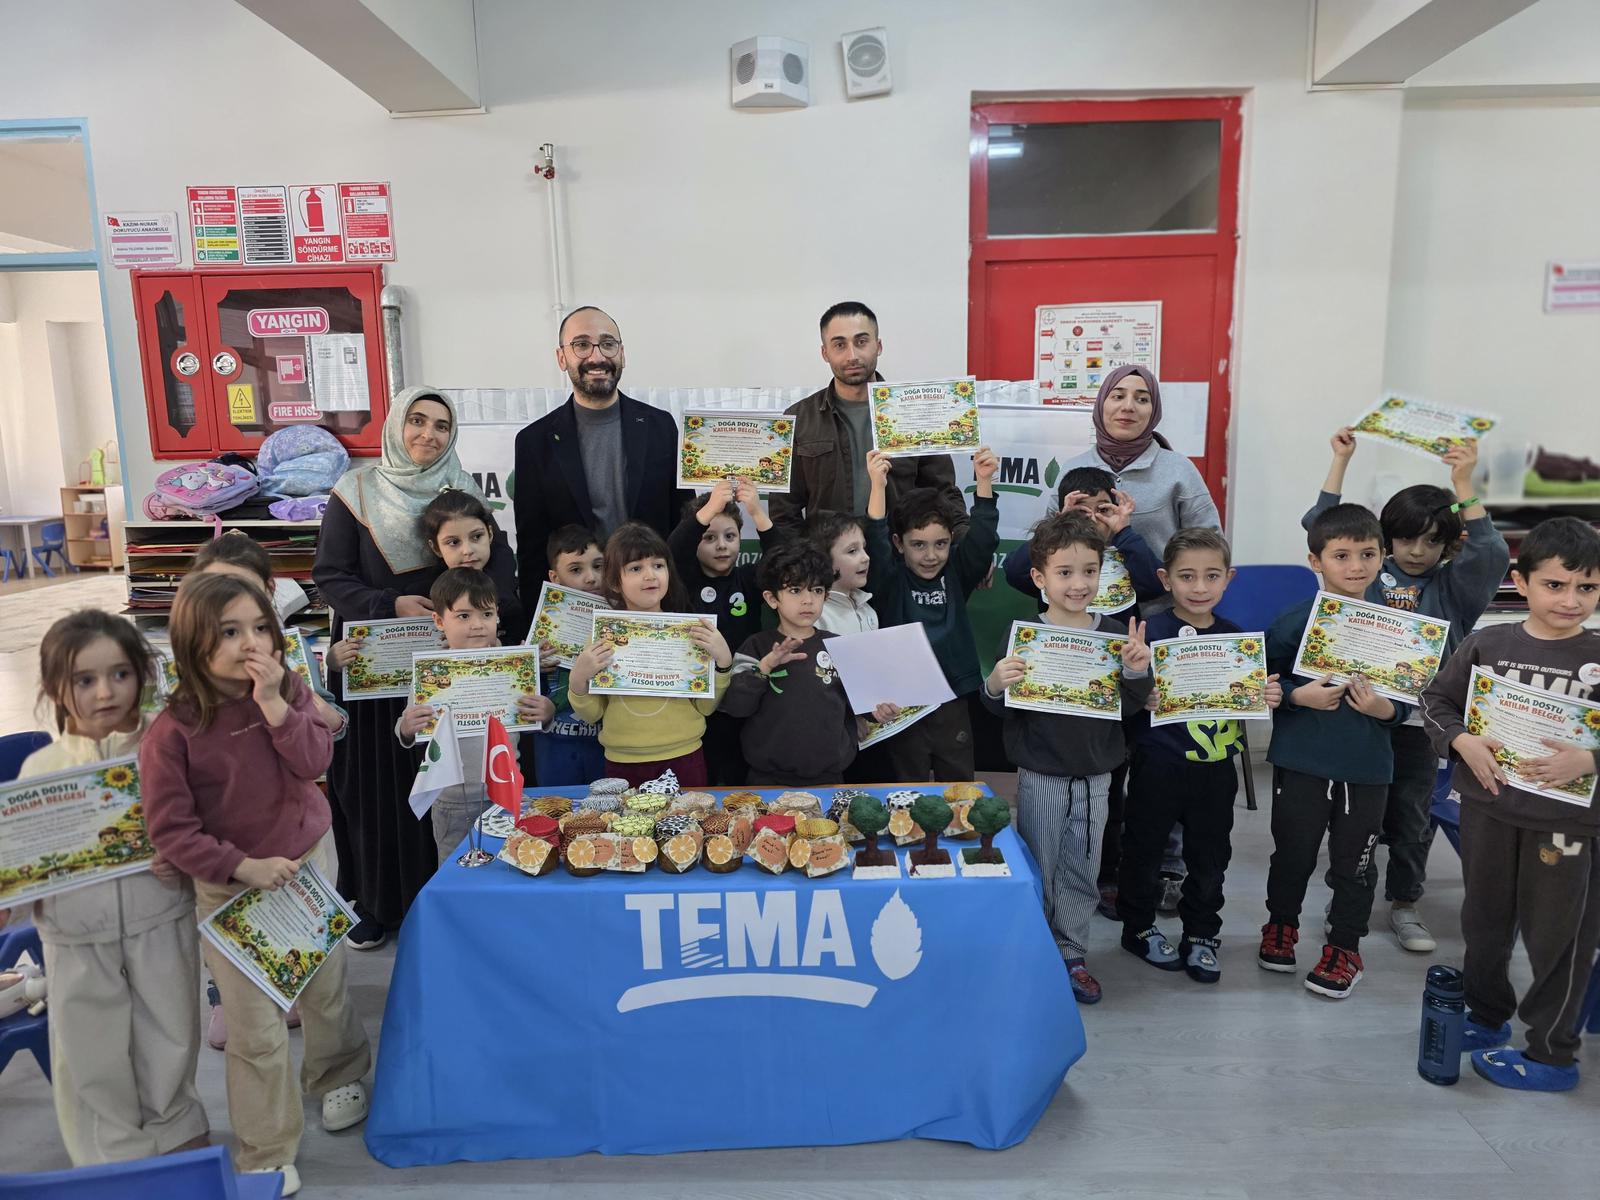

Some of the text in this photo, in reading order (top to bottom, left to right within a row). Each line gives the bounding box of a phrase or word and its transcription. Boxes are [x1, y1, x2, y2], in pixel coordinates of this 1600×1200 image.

[297, 245, 339, 253] SÖNDÜRME
[307, 254, 331, 262] CİHAZI
[256, 313, 321, 329] YANGIN
[274, 406, 294, 416] FIRE
[970, 456, 1040, 484] MA
[729, 592, 747, 616] 3
[1348, 617, 1404, 635] KATILIM BELGESİ
[1356, 612, 1402, 626] DOĞA DOSTU
[380, 632, 406, 640] KATILIM
[1070, 638, 1092, 646] DOSTU
[1070, 644, 1094, 654] BELGESİ
[1176, 652, 1199, 660] KATILIM
[1517, 663, 1540, 672] BETTER
[1540, 666, 1572, 676] OUTDOORS
[1500, 700, 1566, 724] KATILIM BELGESİ
[1507, 693, 1563, 714] DOĞA DOSTU
[8, 783, 78, 805] DOĞA DOSTU
[2, 790, 86, 817] KATILIM BELGESİ
[289, 880, 320, 917] KATILIM BELGESİ
[299, 876, 325, 908] DOĞA DOSTU
[625, 889, 856, 970] TEMA
